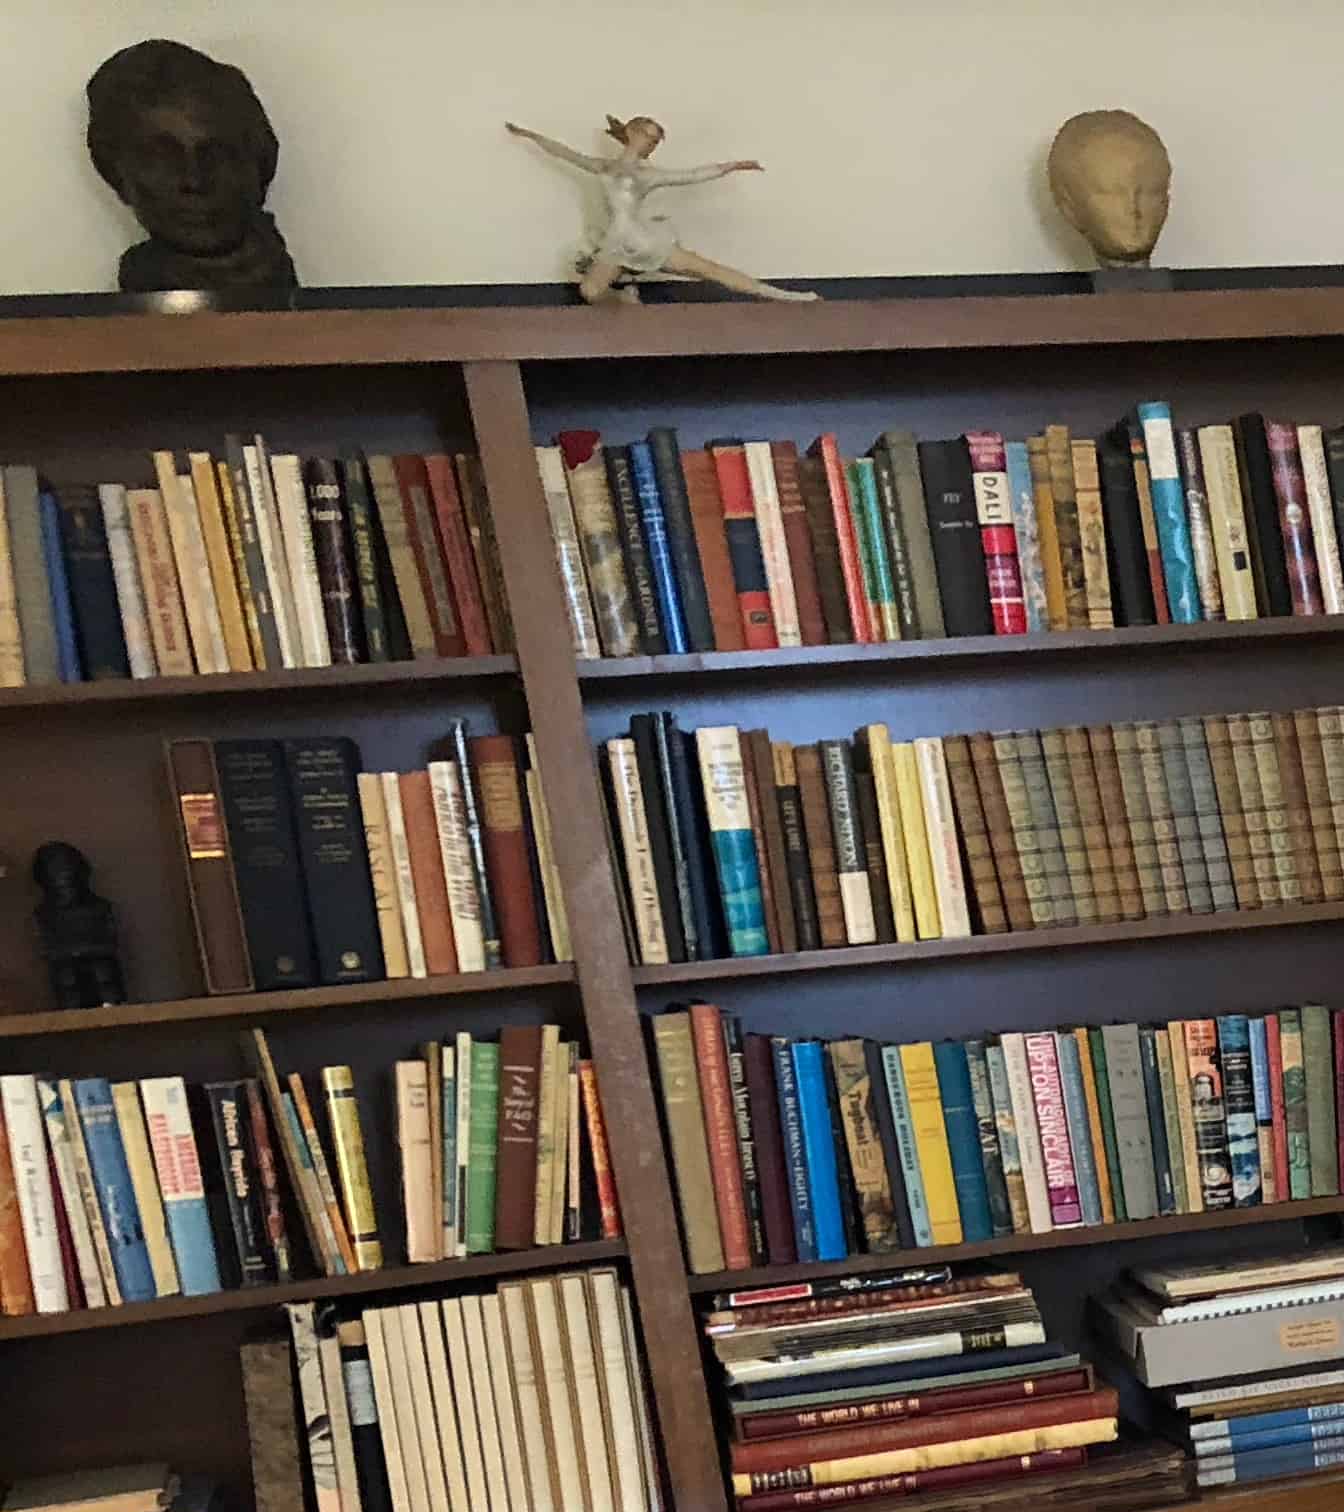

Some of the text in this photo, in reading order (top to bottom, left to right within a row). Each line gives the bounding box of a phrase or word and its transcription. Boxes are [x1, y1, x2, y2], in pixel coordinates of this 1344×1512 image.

[981, 476, 1001, 520] DALI
[839, 817, 859, 867] NIXON
[1026, 1037, 1065, 1188] UPTON SINCLAIR
[798, 1397, 920, 1426] THE WORLD WE LIVE IN
[794, 1491, 816, 1504] THE
[818, 1485, 855, 1502] WORLD
[859, 1482, 875, 1496] WE
[879, 1478, 901, 1491] LIVE
